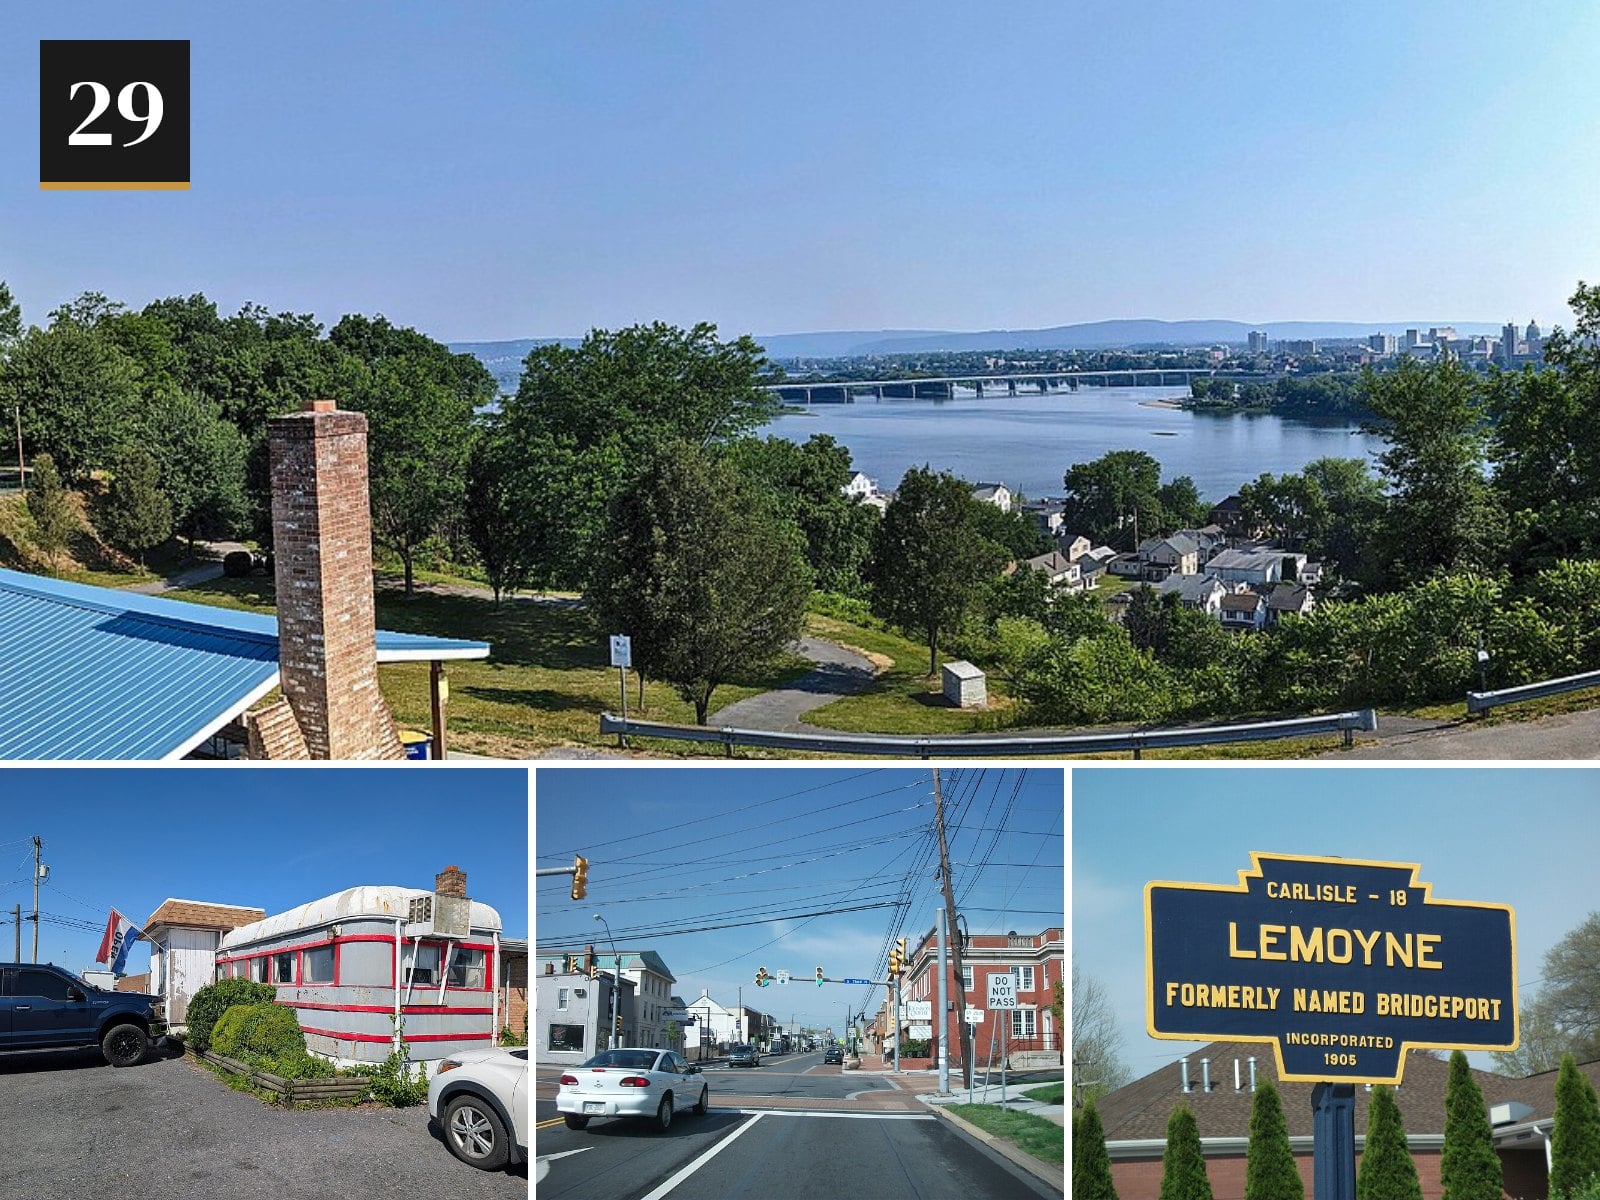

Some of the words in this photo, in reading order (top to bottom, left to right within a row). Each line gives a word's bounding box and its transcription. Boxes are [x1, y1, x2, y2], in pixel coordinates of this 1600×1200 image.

[1267, 881, 1357, 904] CARLISLE
[1390, 889, 1407, 906] 18
[1229, 921, 1443, 970] LEMOYNE
[995, 976, 1008, 986] DO
[992, 987, 1011, 996] NOT
[990, 997, 1015, 1007] PASS
[1166, 982, 1281, 1010] FORMERLY
[1293, 988, 1365, 1015] NAMED
[1377, 993, 1502, 1021] BRIDGEPORT
[1286, 1032, 1394, 1050] INCORPORATED
[1324, 1053, 1357, 1066] 1905
